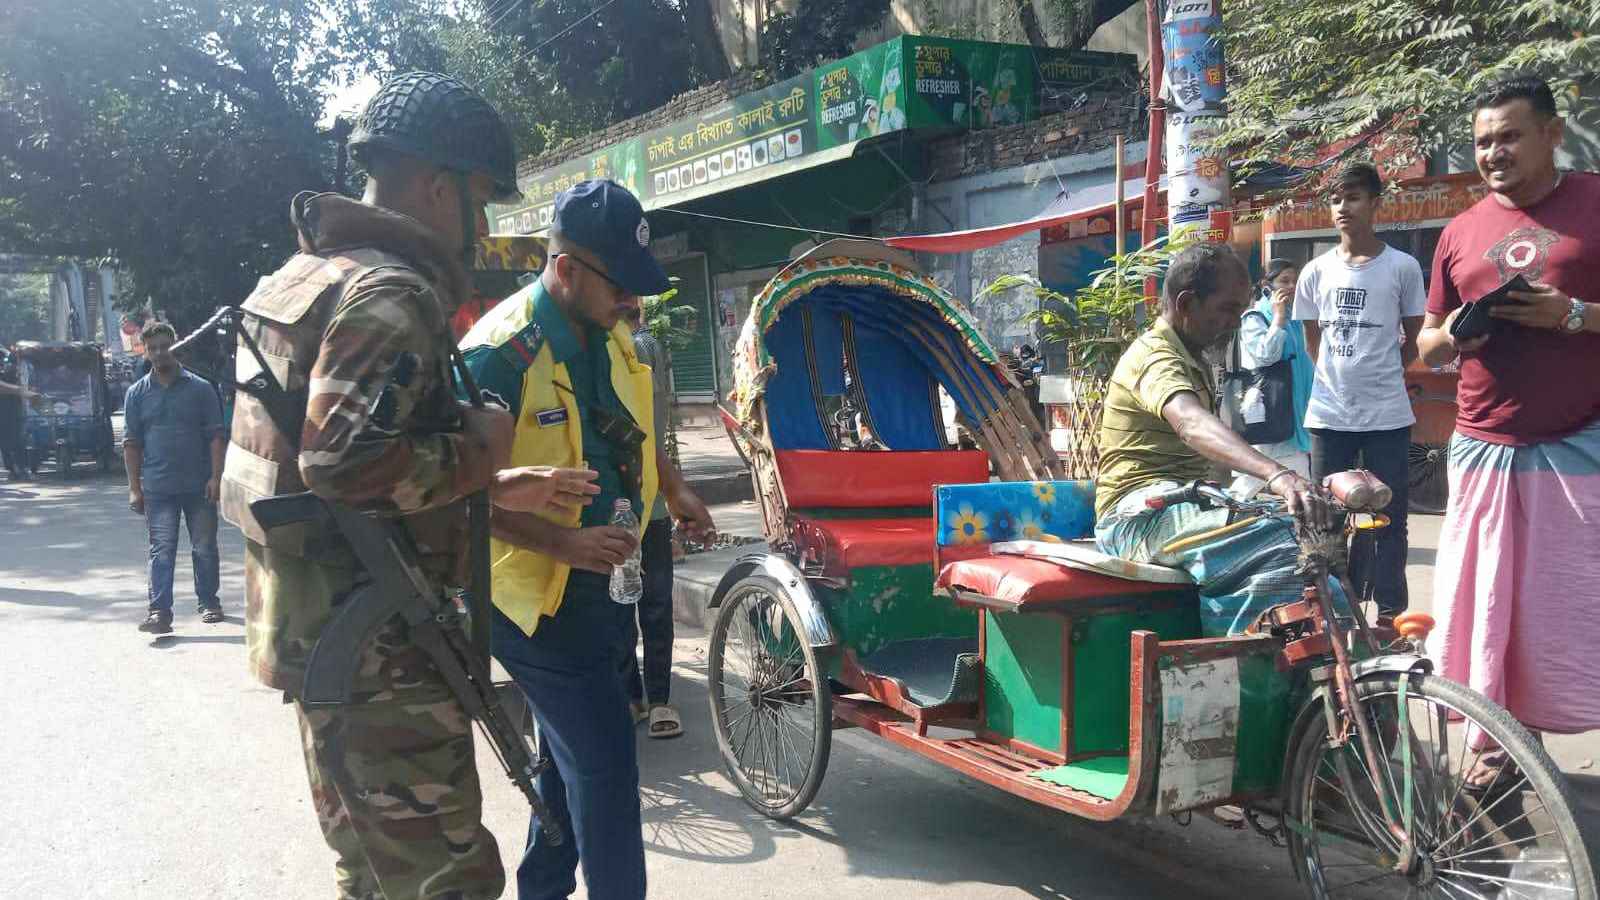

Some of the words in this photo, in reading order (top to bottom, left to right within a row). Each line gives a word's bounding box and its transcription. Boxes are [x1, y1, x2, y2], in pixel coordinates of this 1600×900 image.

[915, 79, 960, 95] REFRESHER
[821, 102, 856, 124] REFRESHER
[647, 136, 677, 161] চাঁপাই
[679, 135, 694, 151] এর
[697, 119, 735, 145] বিখ্যাত
[736, 101, 775, 130] কালাই
[777, 87, 806, 118] রুটি
[1339, 291, 1363, 306] PUBG
